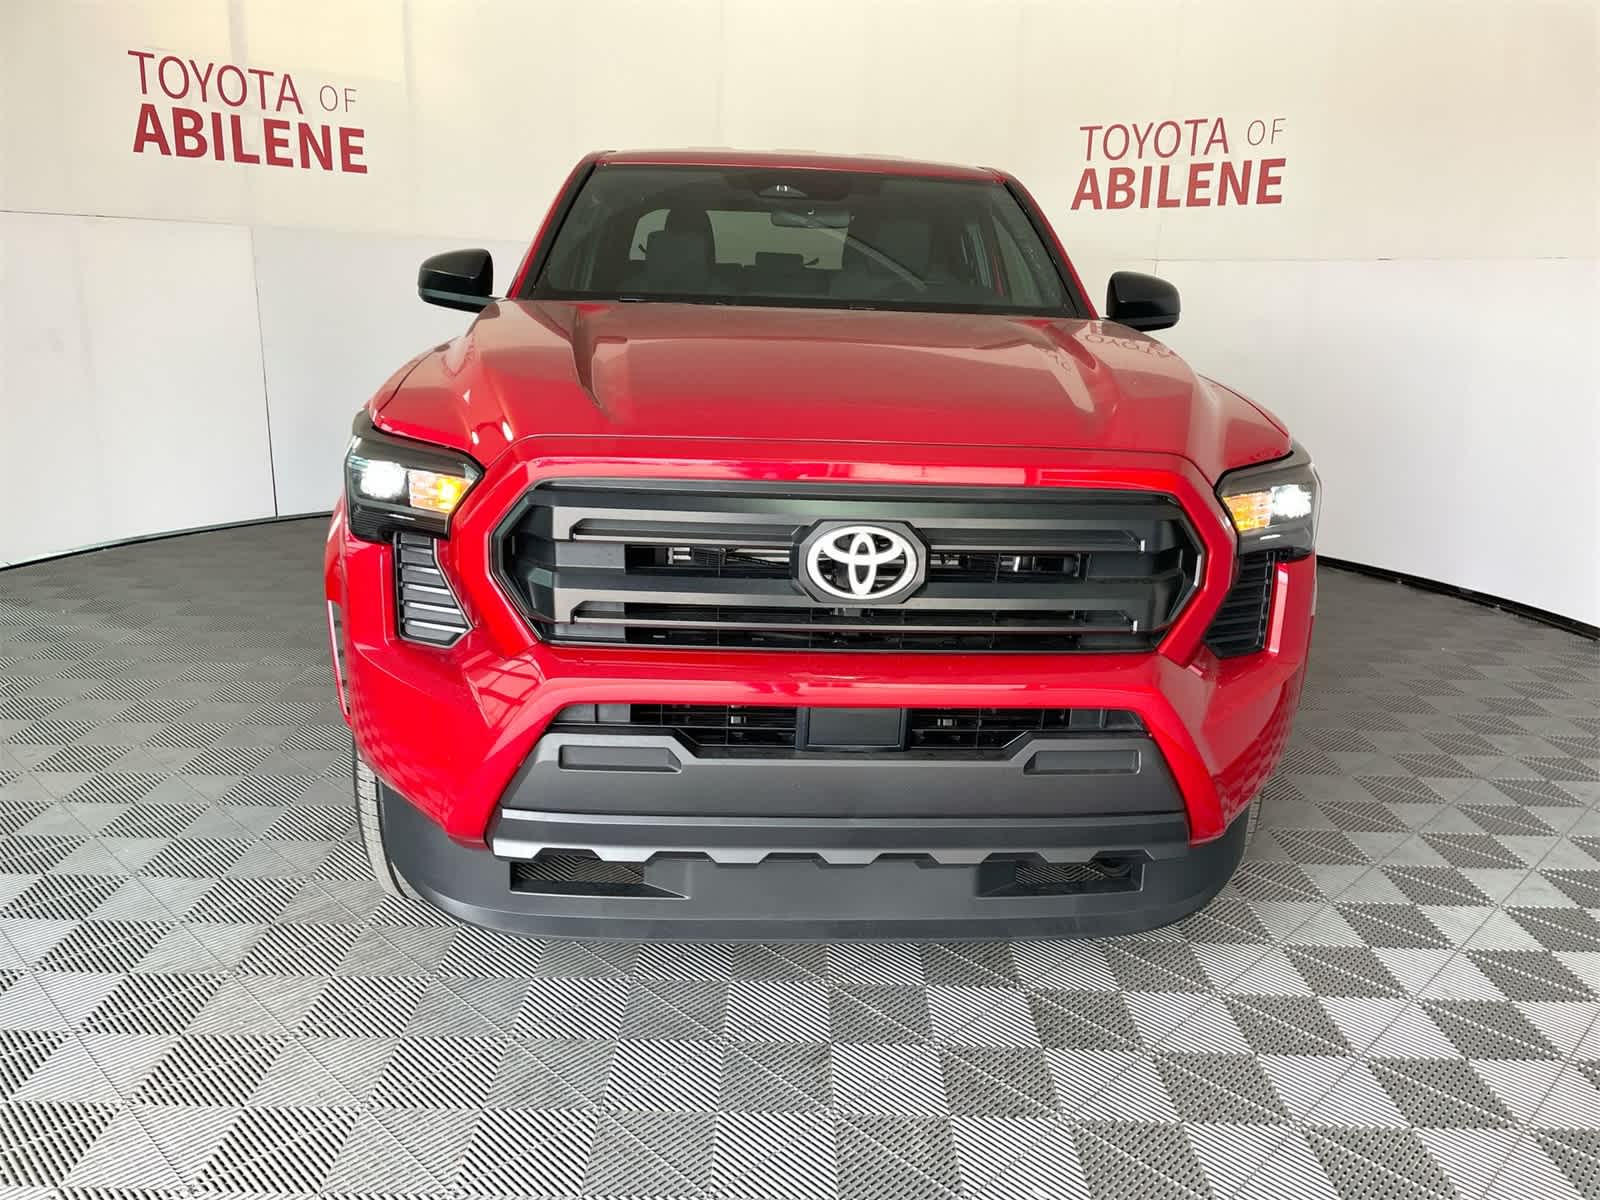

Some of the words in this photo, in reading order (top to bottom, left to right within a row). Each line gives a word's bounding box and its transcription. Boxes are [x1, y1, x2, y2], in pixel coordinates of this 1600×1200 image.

[128, 50, 303, 114] TOYOTA
[319, 84, 357, 112] OF
[133, 103, 368, 174] ABILENE
[1079, 117, 1229, 161] TOYOTA
[1247, 118, 1287, 146] OF
[1070, 158, 1287, 210] ABILENE
